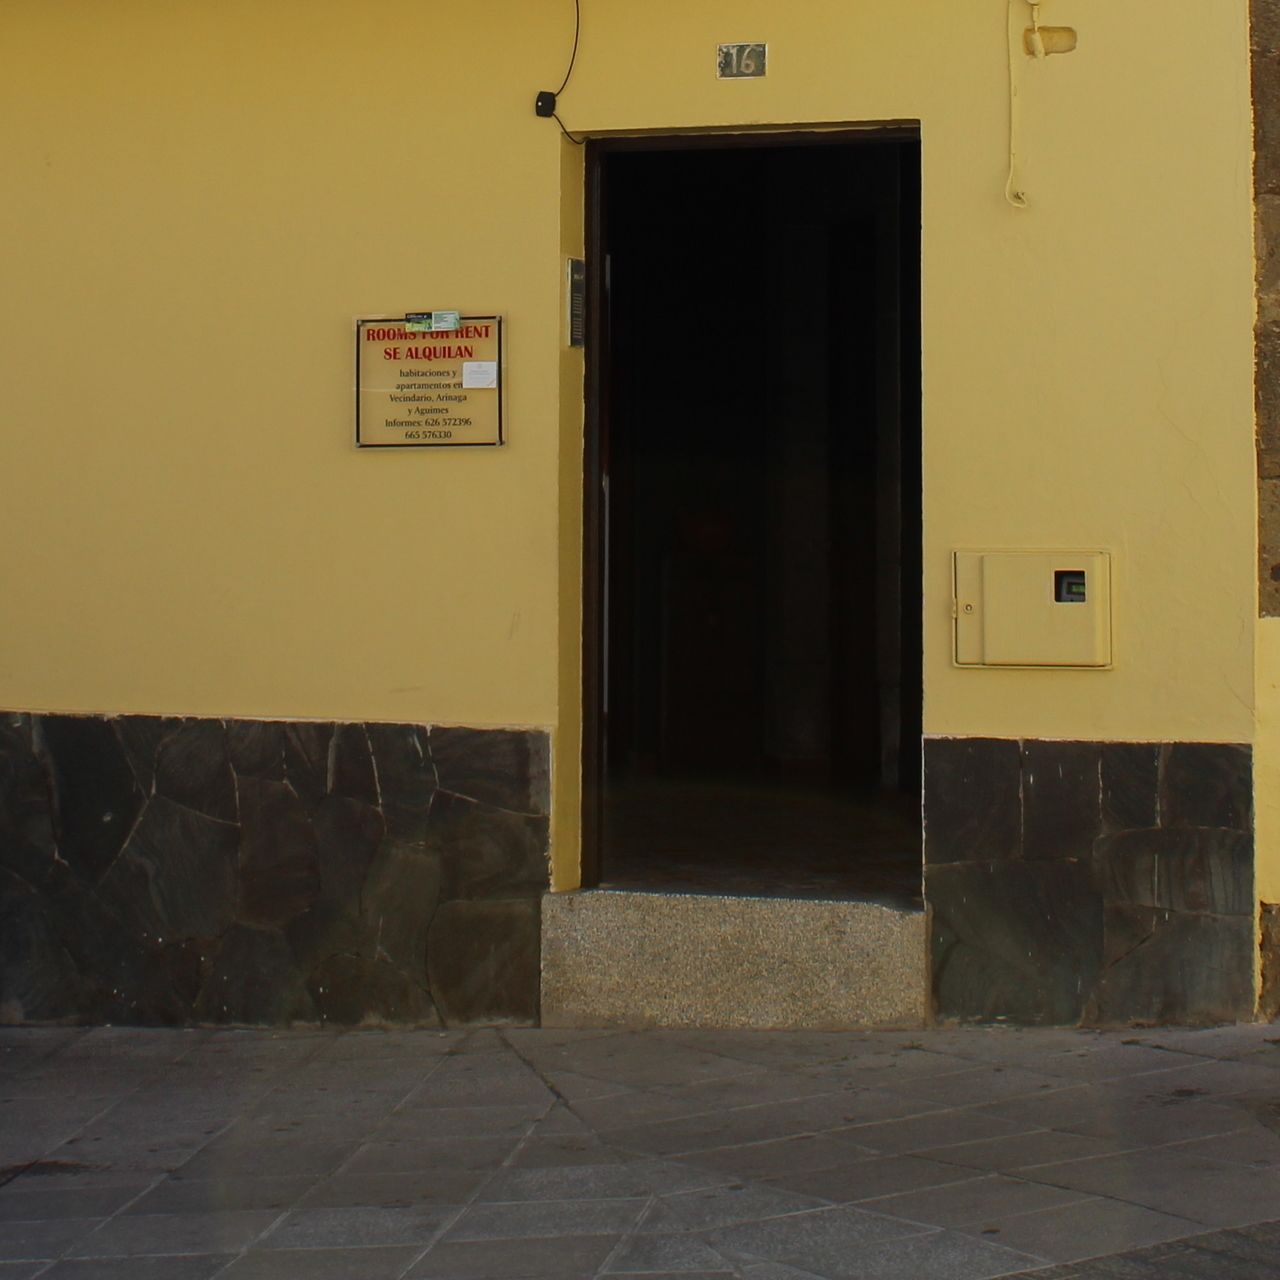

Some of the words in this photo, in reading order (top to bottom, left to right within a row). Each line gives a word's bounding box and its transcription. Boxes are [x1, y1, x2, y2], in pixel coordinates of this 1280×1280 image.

[729, 46, 755, 74] 16
[366, 328, 417, 342] ROOMS
[455, 325, 491, 339] RENT
[383, 347, 401, 360] SE
[405, 345, 474, 361] ALQUILAN
[399, 368, 450, 378] habitaciones
[451, 370, 457, 378] y
[395, 382, 451, 392] apartamentos
[389, 394, 434, 403] Vecindario,
[437, 393, 467, 402] Arinaga
[407, 407, 413, 415] y
[385, 418, 422, 427] Informes:
[424, 418, 441, 427] 626
[404, 431, 420, 439] 665
